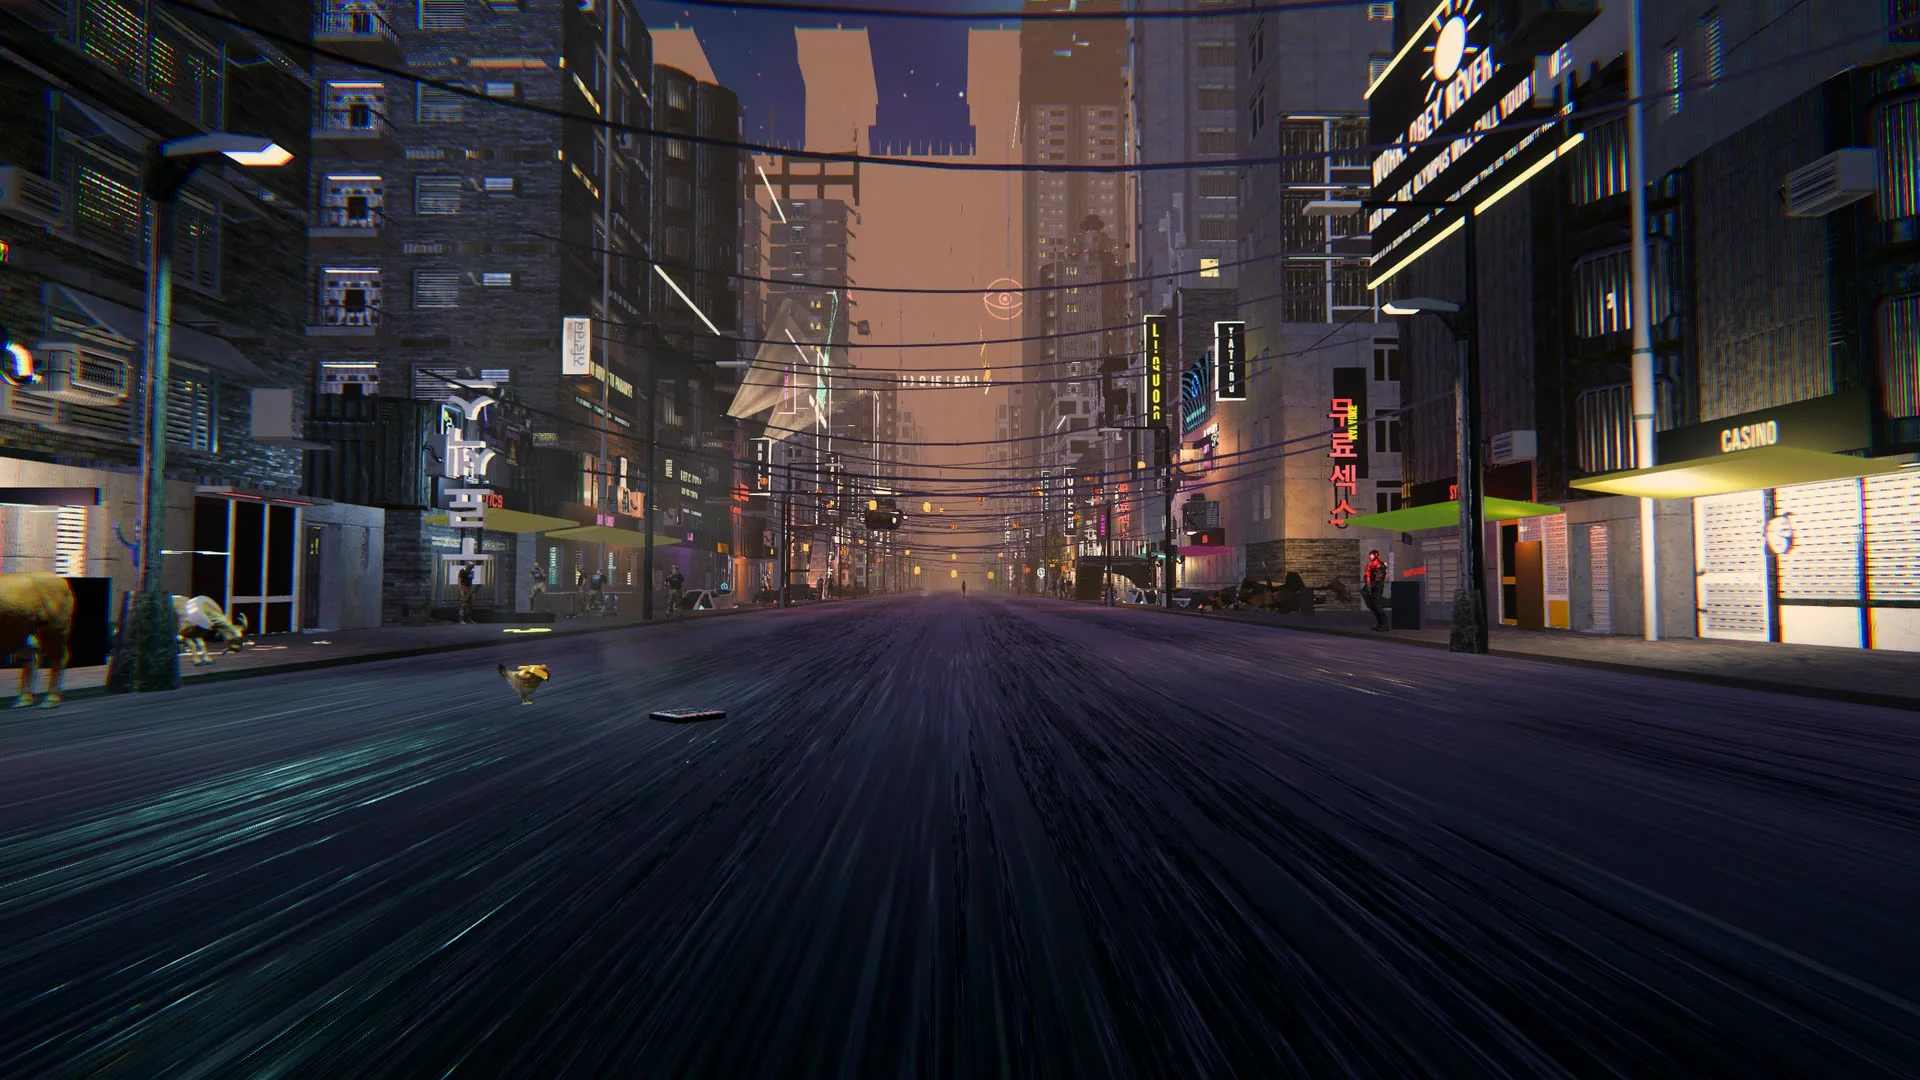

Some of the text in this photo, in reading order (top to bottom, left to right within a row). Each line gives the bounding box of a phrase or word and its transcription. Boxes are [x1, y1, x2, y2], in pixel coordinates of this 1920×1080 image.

[1372, 45, 1495, 189] WORK. OBEY. NEVER
[1413, 147, 1450, 195] OLYMPUS
[1500, 76, 1530, 120] YOUR
[1152, 323, 1161, 420] LIQUOR
[1327, 398, 1358, 525] 무료섹스
[1721, 420, 1780, 453] CASINO
